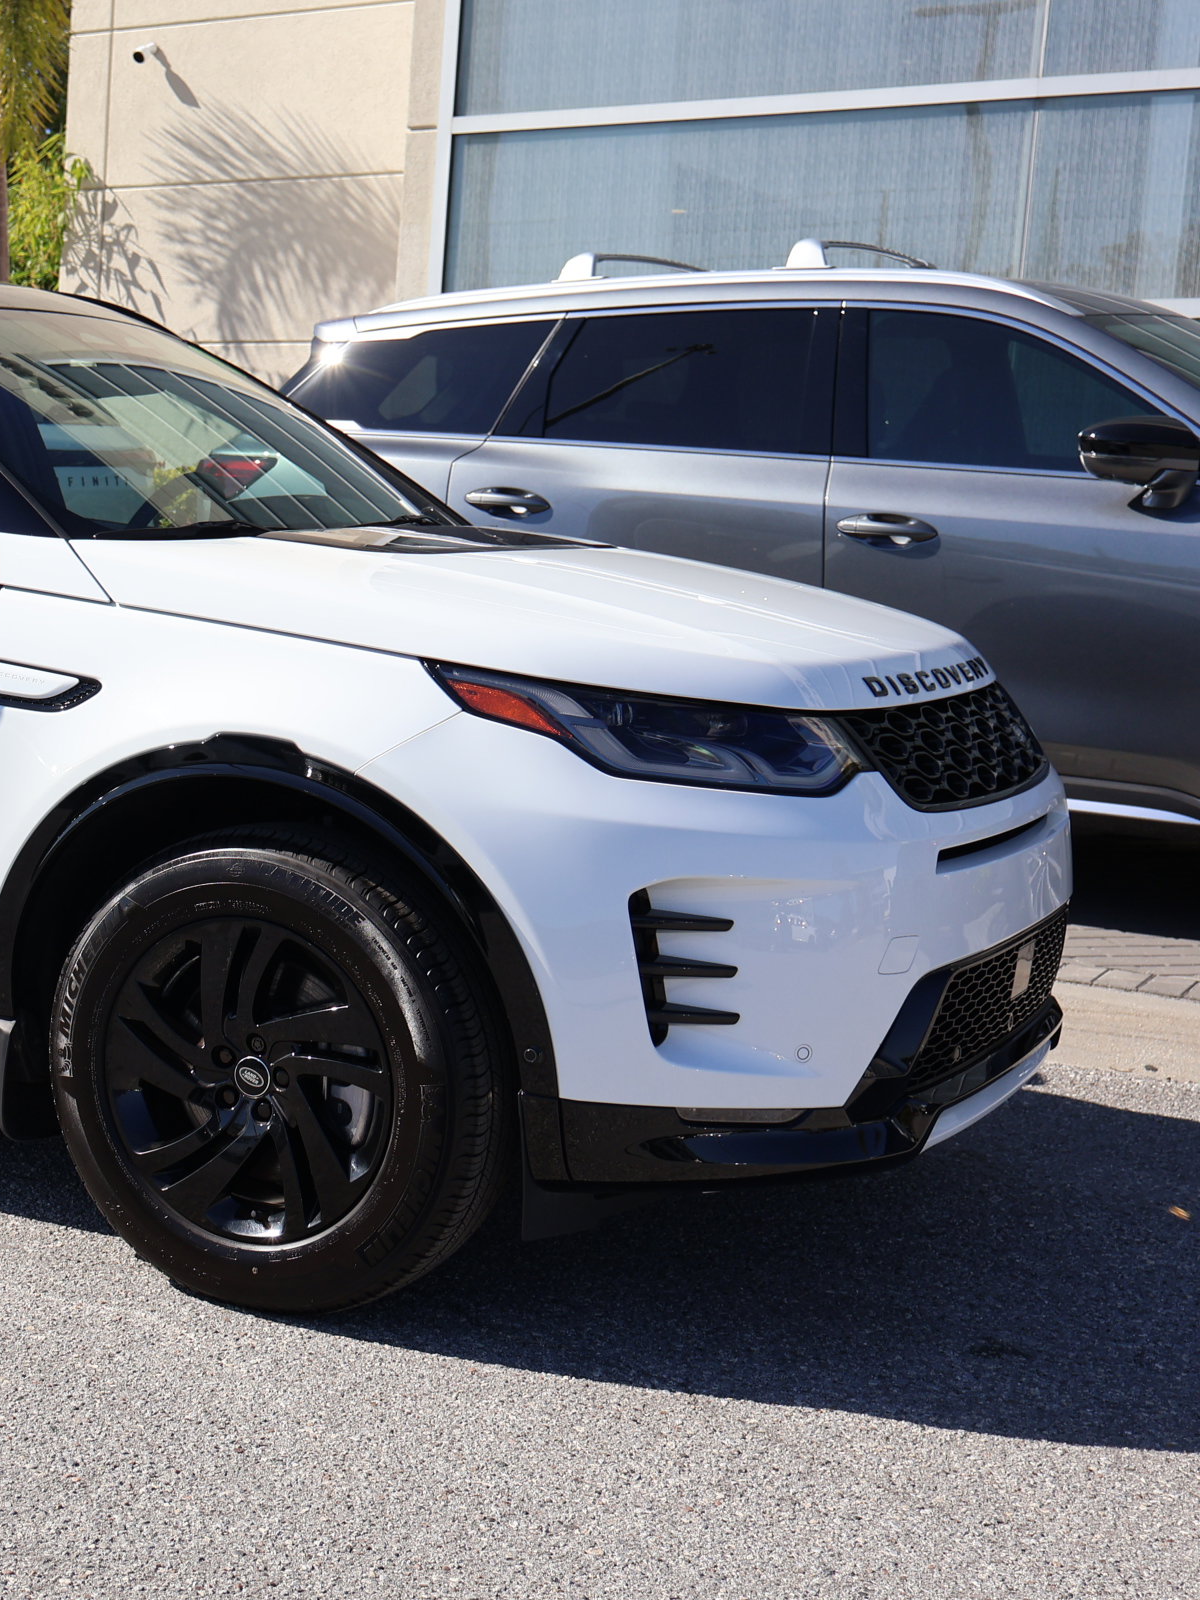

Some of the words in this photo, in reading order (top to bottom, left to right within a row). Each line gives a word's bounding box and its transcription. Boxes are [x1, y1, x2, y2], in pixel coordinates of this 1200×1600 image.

[862, 656, 990, 698] DISCOVERY
[243, 1074, 259, 1085] ROVER
[244, 1069, 257, 1079] LAND
